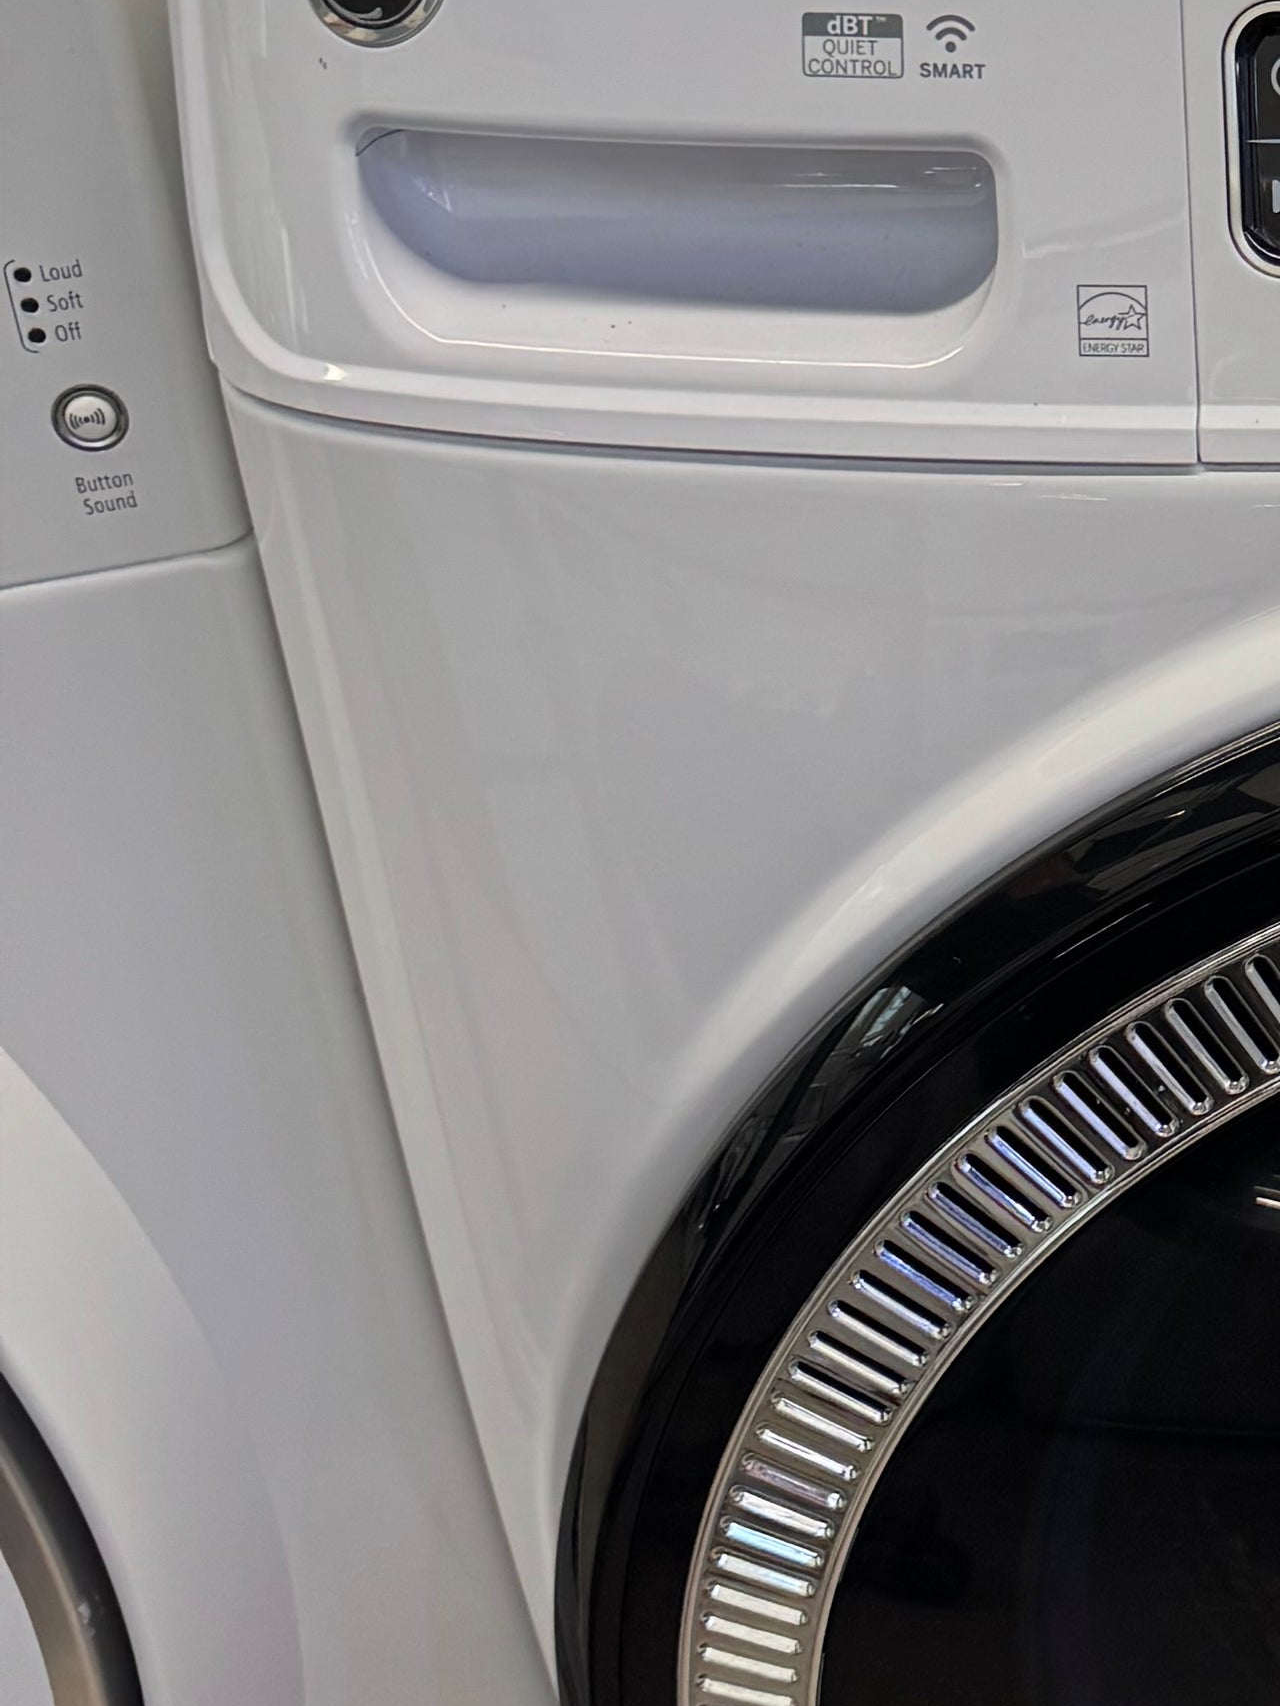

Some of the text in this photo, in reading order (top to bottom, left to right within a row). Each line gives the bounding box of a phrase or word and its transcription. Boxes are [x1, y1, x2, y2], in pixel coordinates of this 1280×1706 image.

[823, 40, 878, 57] QUIET
[808, 59, 897, 76] CONTROL
[920, 63, 985, 79] SMART
[39, 259, 82, 282] Loud
[47, 291, 83, 312] Soft
[55, 322, 81, 342] Off
[1083, 342, 1144, 353] ENERGY STAR
[75, 472, 134, 494] Button
[83, 491, 137, 516] Sound
